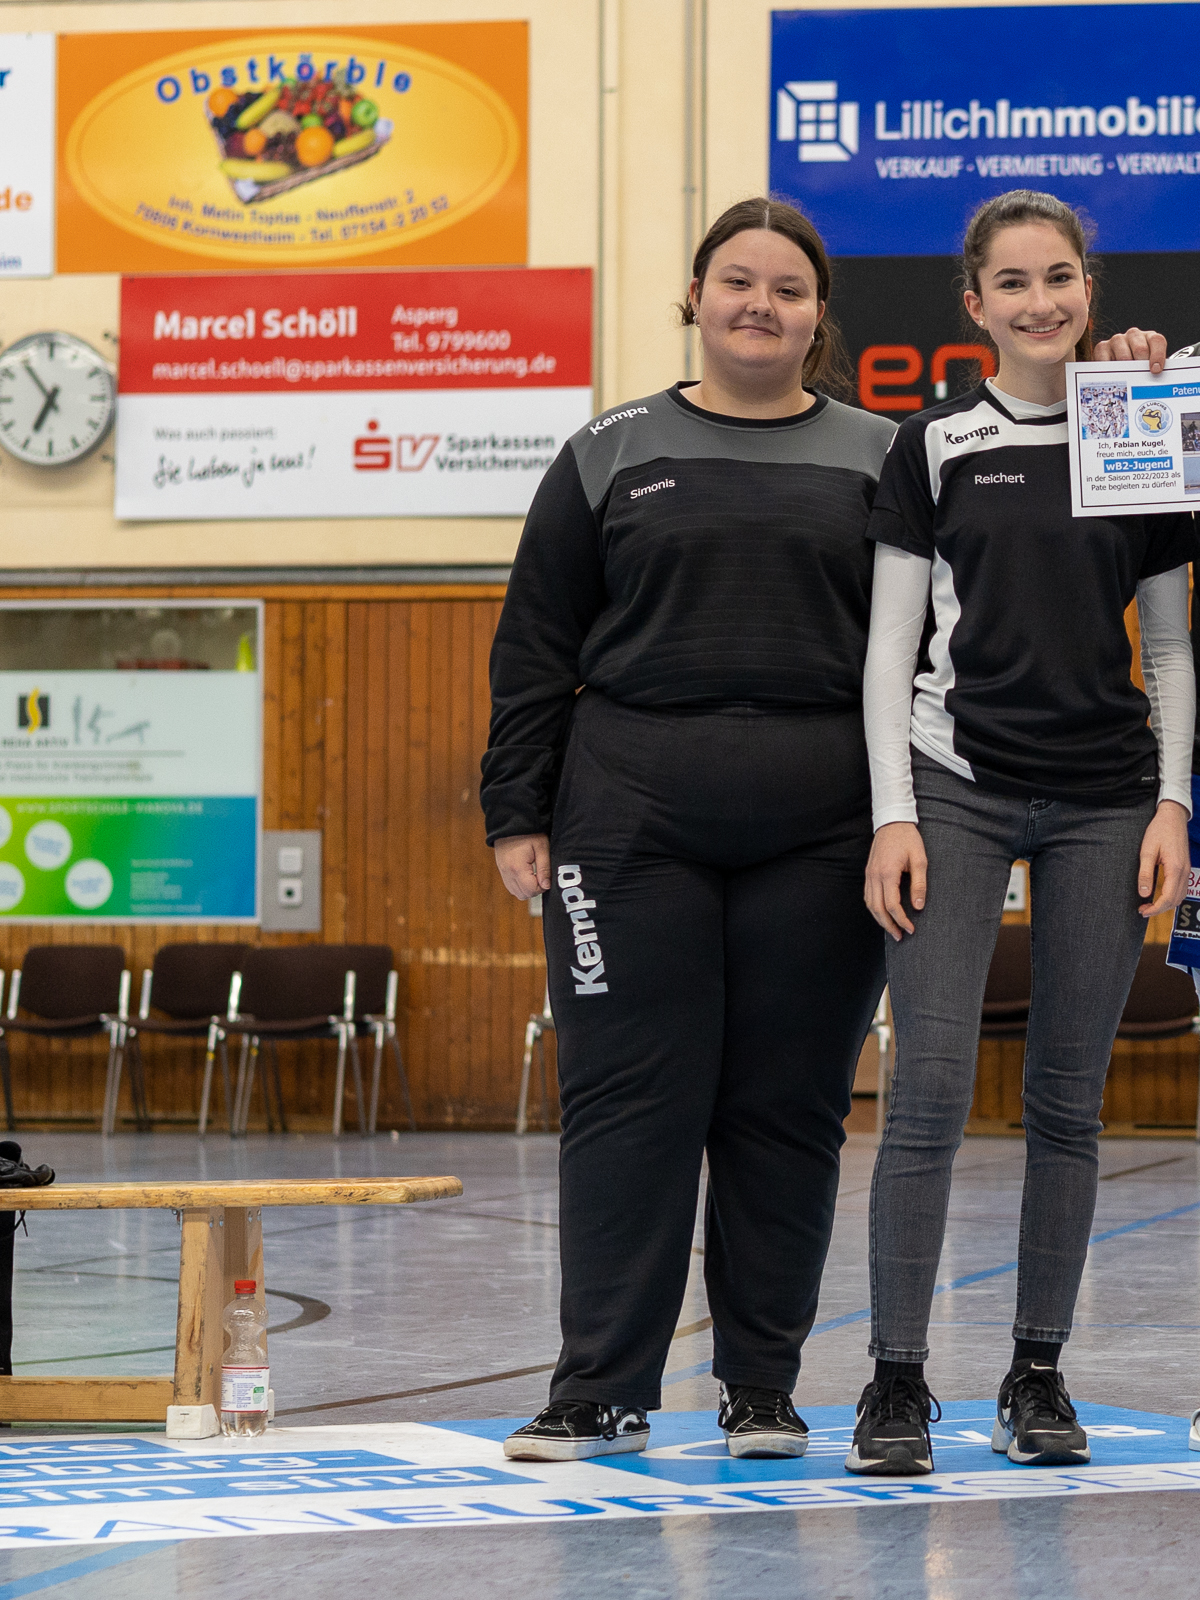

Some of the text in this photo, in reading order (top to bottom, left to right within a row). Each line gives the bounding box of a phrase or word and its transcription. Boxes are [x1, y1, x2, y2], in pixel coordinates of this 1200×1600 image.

[156, 53, 412, 103] Obstkörble
[876, 156, 963, 179] VERKAUF
[976, 154, 1102, 177] VERMIETUNG
[154, 306, 358, 340] Marcel Schöll
[391, 305, 459, 329] Asperg
[392, 329, 511, 353] Tel. 9799600
[589, 406, 649, 435] Kempa
[447, 433, 555, 452] Sparkassen
[944, 425, 1000, 445] Kempa
[1114, 441, 1139, 449] Fabian
[1141, 440, 1166, 449] Kugel,
[1096, 451, 1114, 459] freue
[1158, 448, 1168, 456] die
[1105, 459, 1171, 471] wB2-Jugend
[974, 472, 1025, 485] Reichert
[1108, 473, 1130, 482] Saison
[1132, 472, 1169, 482] 2022/2023
[1170, 471, 1181, 479] als
[1108, 482, 1140, 492] begleiten
[630, 478, 676, 500] Simonis
[557, 864, 609, 994] Kempa
[227, 1469, 492, 1492] sind
